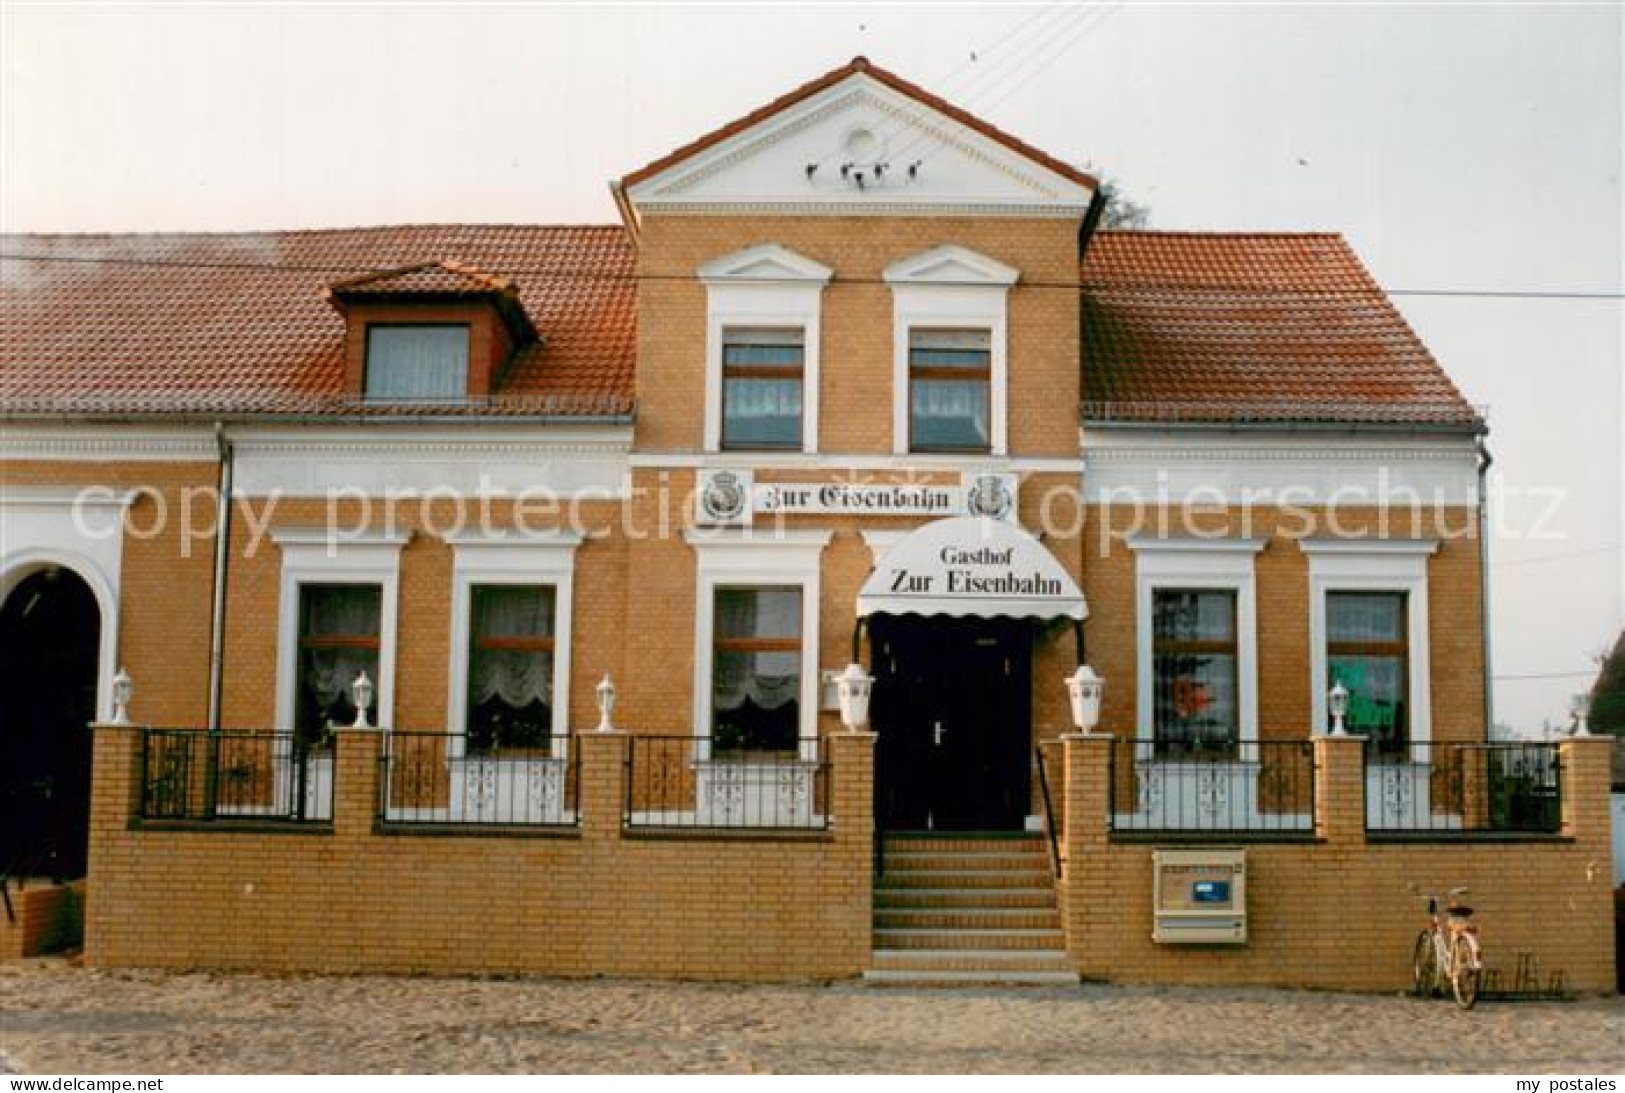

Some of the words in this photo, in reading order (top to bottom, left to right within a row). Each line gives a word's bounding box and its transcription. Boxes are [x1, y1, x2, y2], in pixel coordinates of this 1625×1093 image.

[764, 485, 811, 511] Zur
[819, 485, 950, 513] Eisenbahn
[940, 546, 1015, 566] Gasthof
[890, 570, 934, 593] Zur
[947, 570, 1063, 597] Eisenbahn
